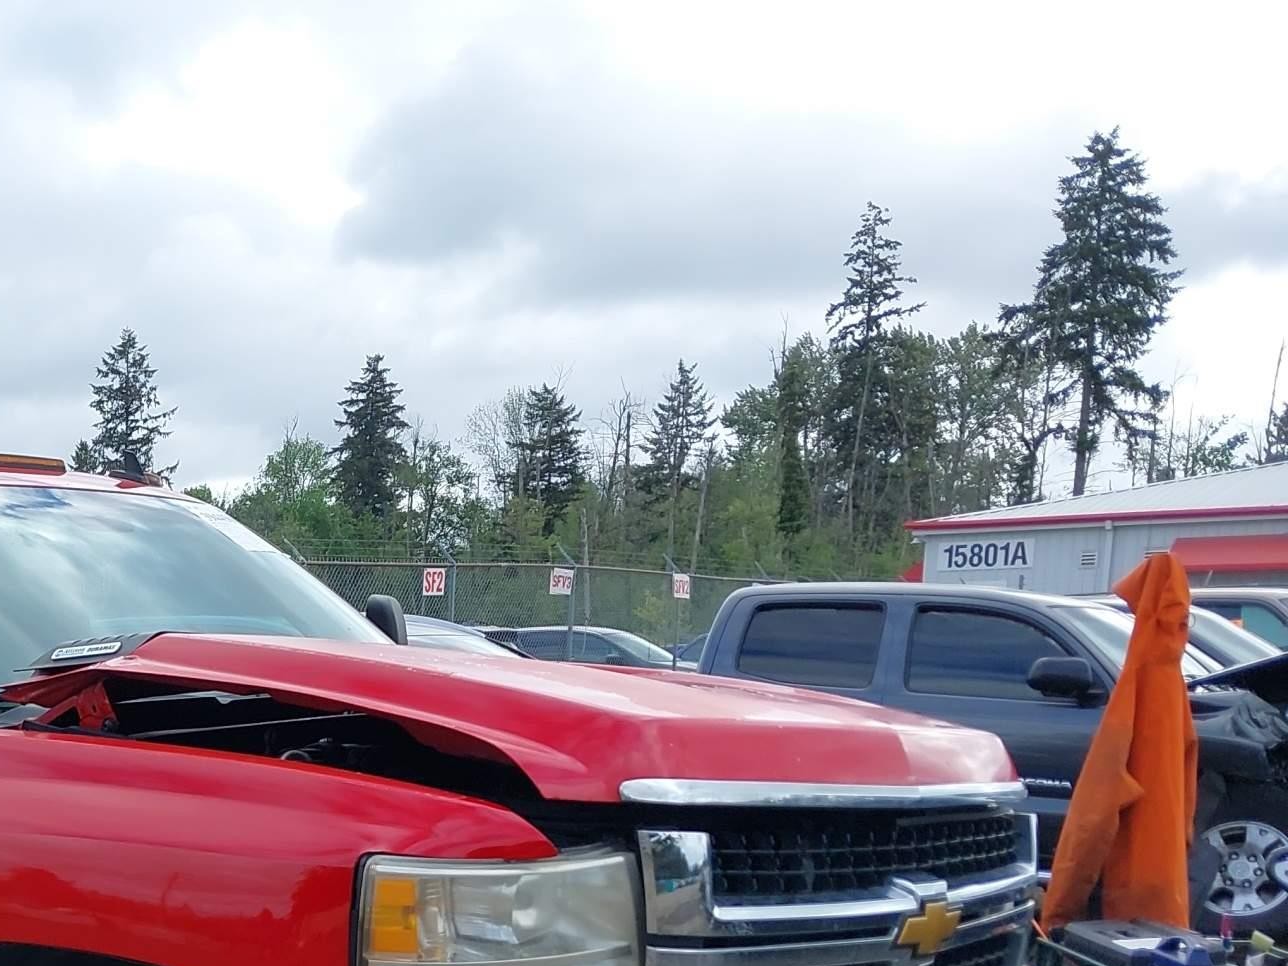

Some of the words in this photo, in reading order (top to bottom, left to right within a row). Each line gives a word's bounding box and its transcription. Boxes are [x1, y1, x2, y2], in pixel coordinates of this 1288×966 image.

[943, 541, 1028, 568] 15801A
[424, 571, 444, 593] SF2
[552, 575, 572, 589] SFV3
